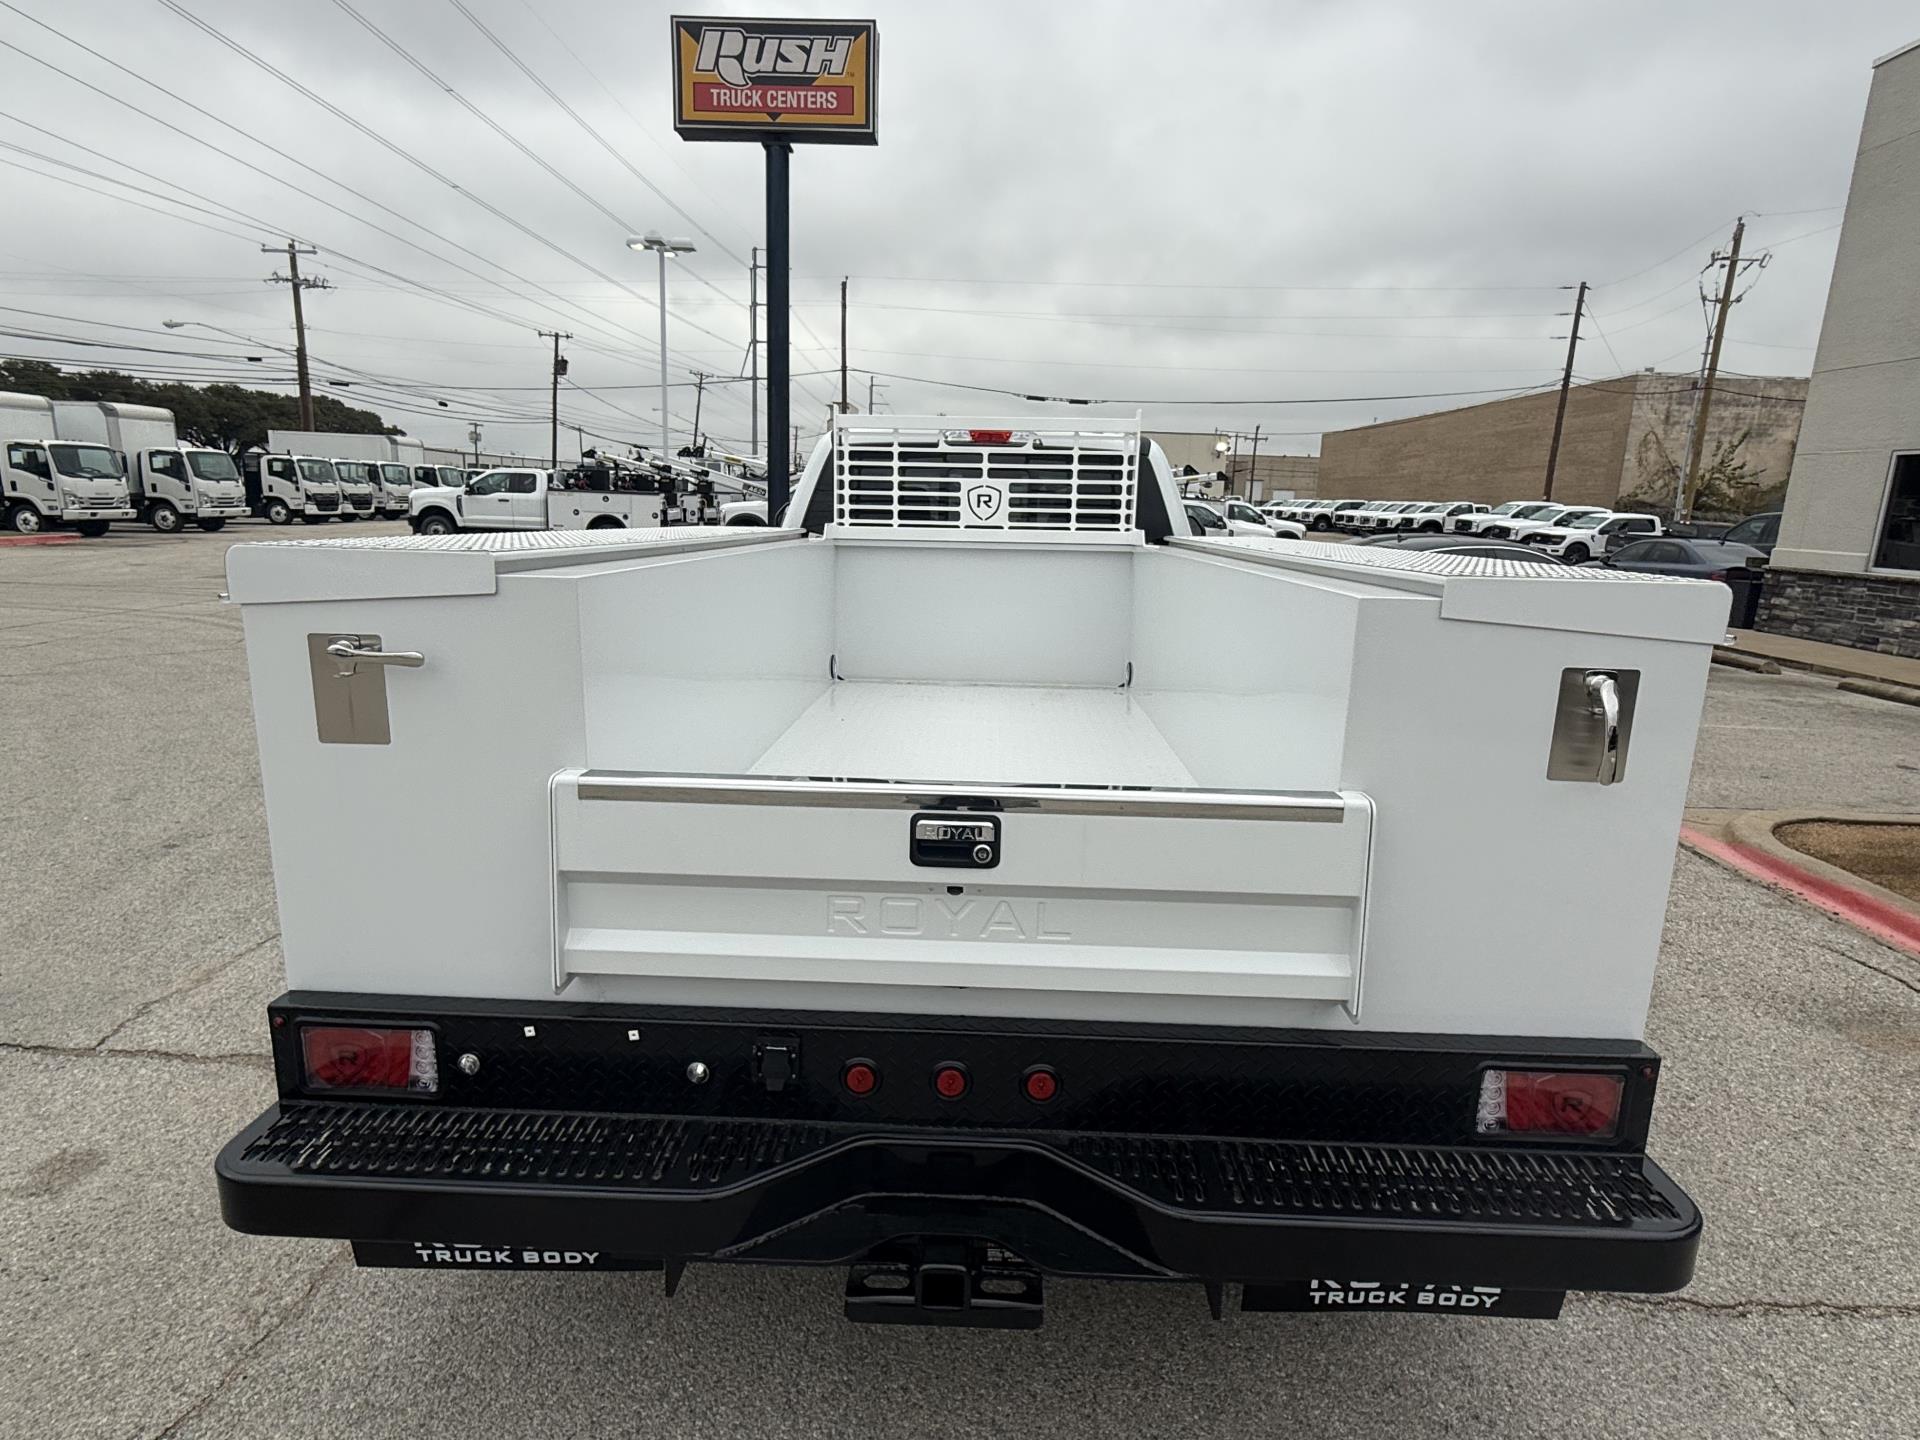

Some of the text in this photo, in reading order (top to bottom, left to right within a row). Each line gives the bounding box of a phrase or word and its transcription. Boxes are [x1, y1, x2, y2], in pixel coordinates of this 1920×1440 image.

[694, 27, 853, 88] RUSH
[710, 88, 838, 109] TRUCK CENTERS
[977, 494, 993, 508] R
[925, 825, 985, 840] ROYAL
[826, 894, 1073, 941] ROYAL
[416, 1249, 600, 1264] TRUCK BODY
[1309, 1290, 1499, 1308] TRUCK BODY
